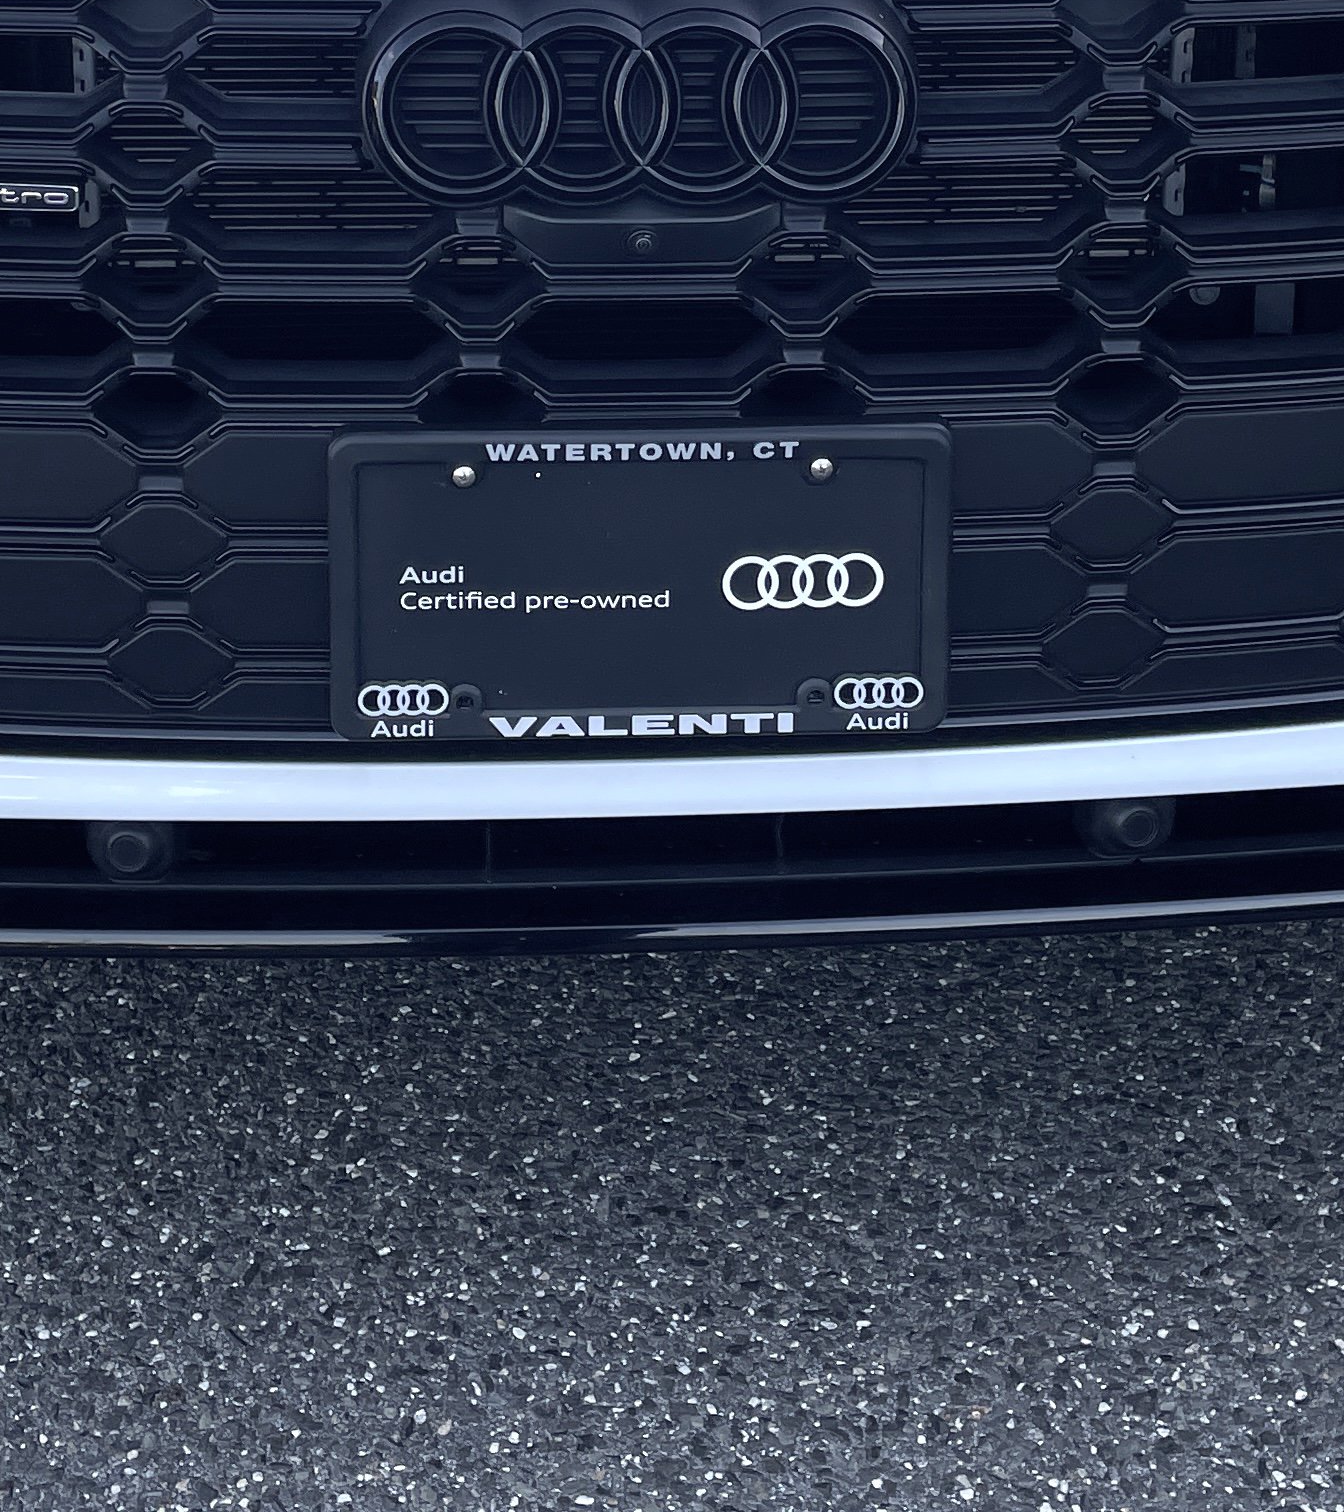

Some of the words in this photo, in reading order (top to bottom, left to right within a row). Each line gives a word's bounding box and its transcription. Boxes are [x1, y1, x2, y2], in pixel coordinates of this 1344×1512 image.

[485, 441, 735, 462] WATERTOWN,
[752, 440, 800, 460] CT
[398, 565, 465, 585] Audi
[399, 591, 516, 611] Certified
[525, 589, 671, 614] pre-owned
[370, 718, 435, 739] Audi
[488, 712, 795, 738] VALENTI
[846, 712, 909, 732] Audi
